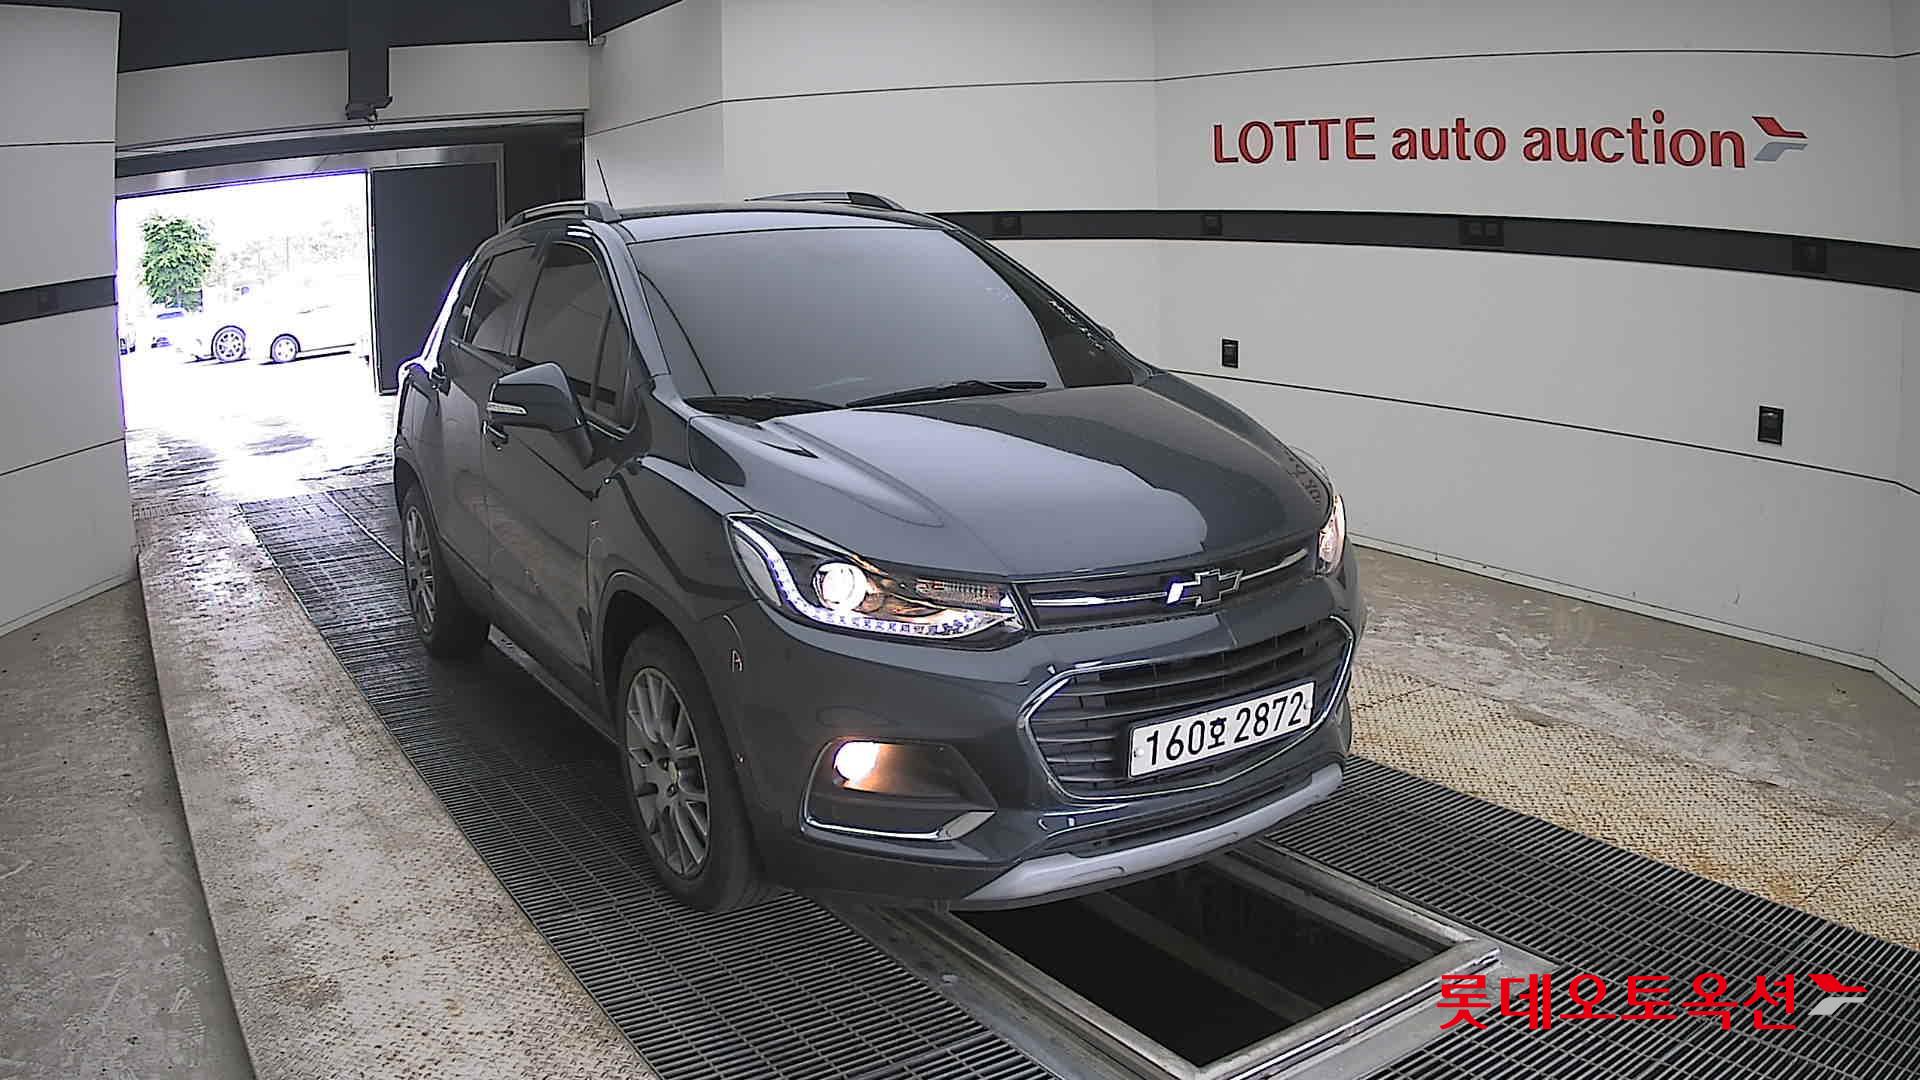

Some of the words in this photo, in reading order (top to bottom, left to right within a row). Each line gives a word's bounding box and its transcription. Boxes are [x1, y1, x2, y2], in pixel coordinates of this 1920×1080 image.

[1213, 117, 1376, 163] LOTTE
[1391, 117, 1507, 162] auto
[1522, 110, 1746, 168] auction
[1146, 717, 1226, 765] 160호
[1234, 691, 1303, 743] 2872
